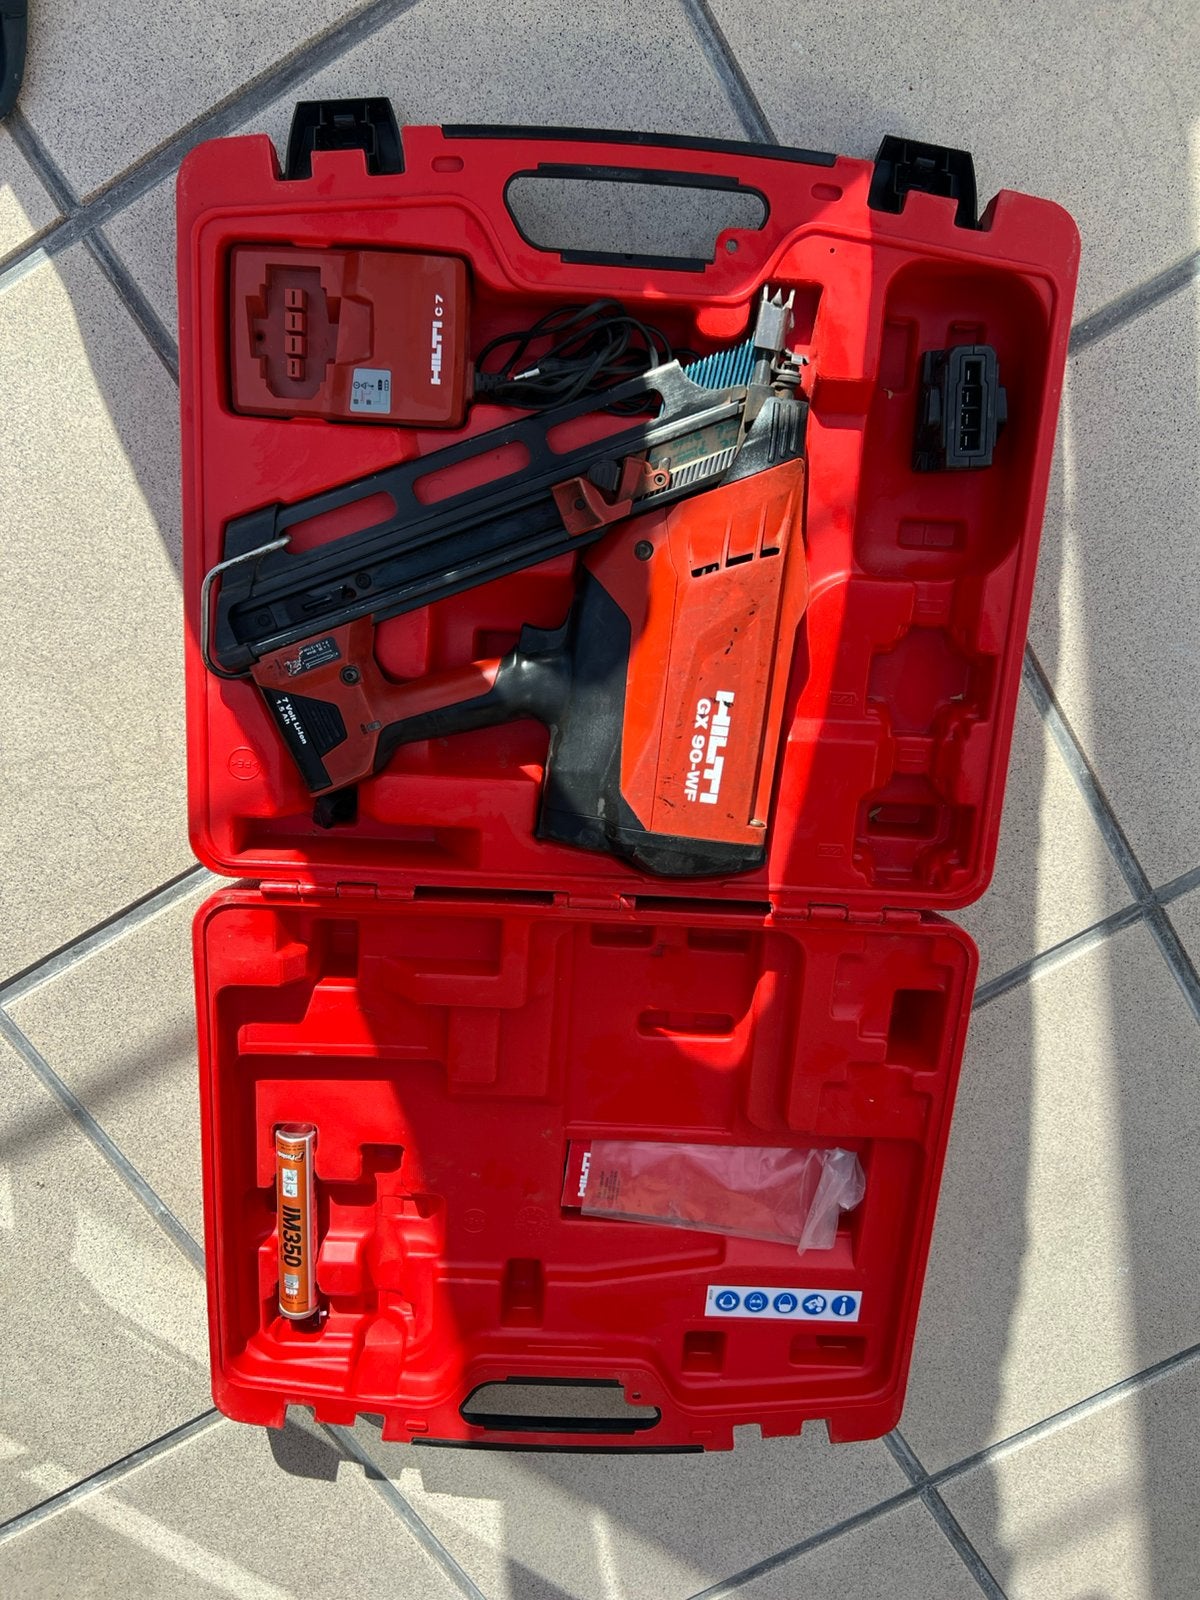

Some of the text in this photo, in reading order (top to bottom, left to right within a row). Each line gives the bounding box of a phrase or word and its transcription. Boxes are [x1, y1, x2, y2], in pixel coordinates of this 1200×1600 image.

[431, 294, 443, 385] HILTI C 7
[282, 713, 290, 725] Ah
[286, 704, 297, 721] Volt
[684, 698, 711, 802] GX 90-WF
[699, 690, 735, 804] HILTI
[577, 1152, 591, 1197] HILTI
[282, 1205, 302, 1268] IM350
